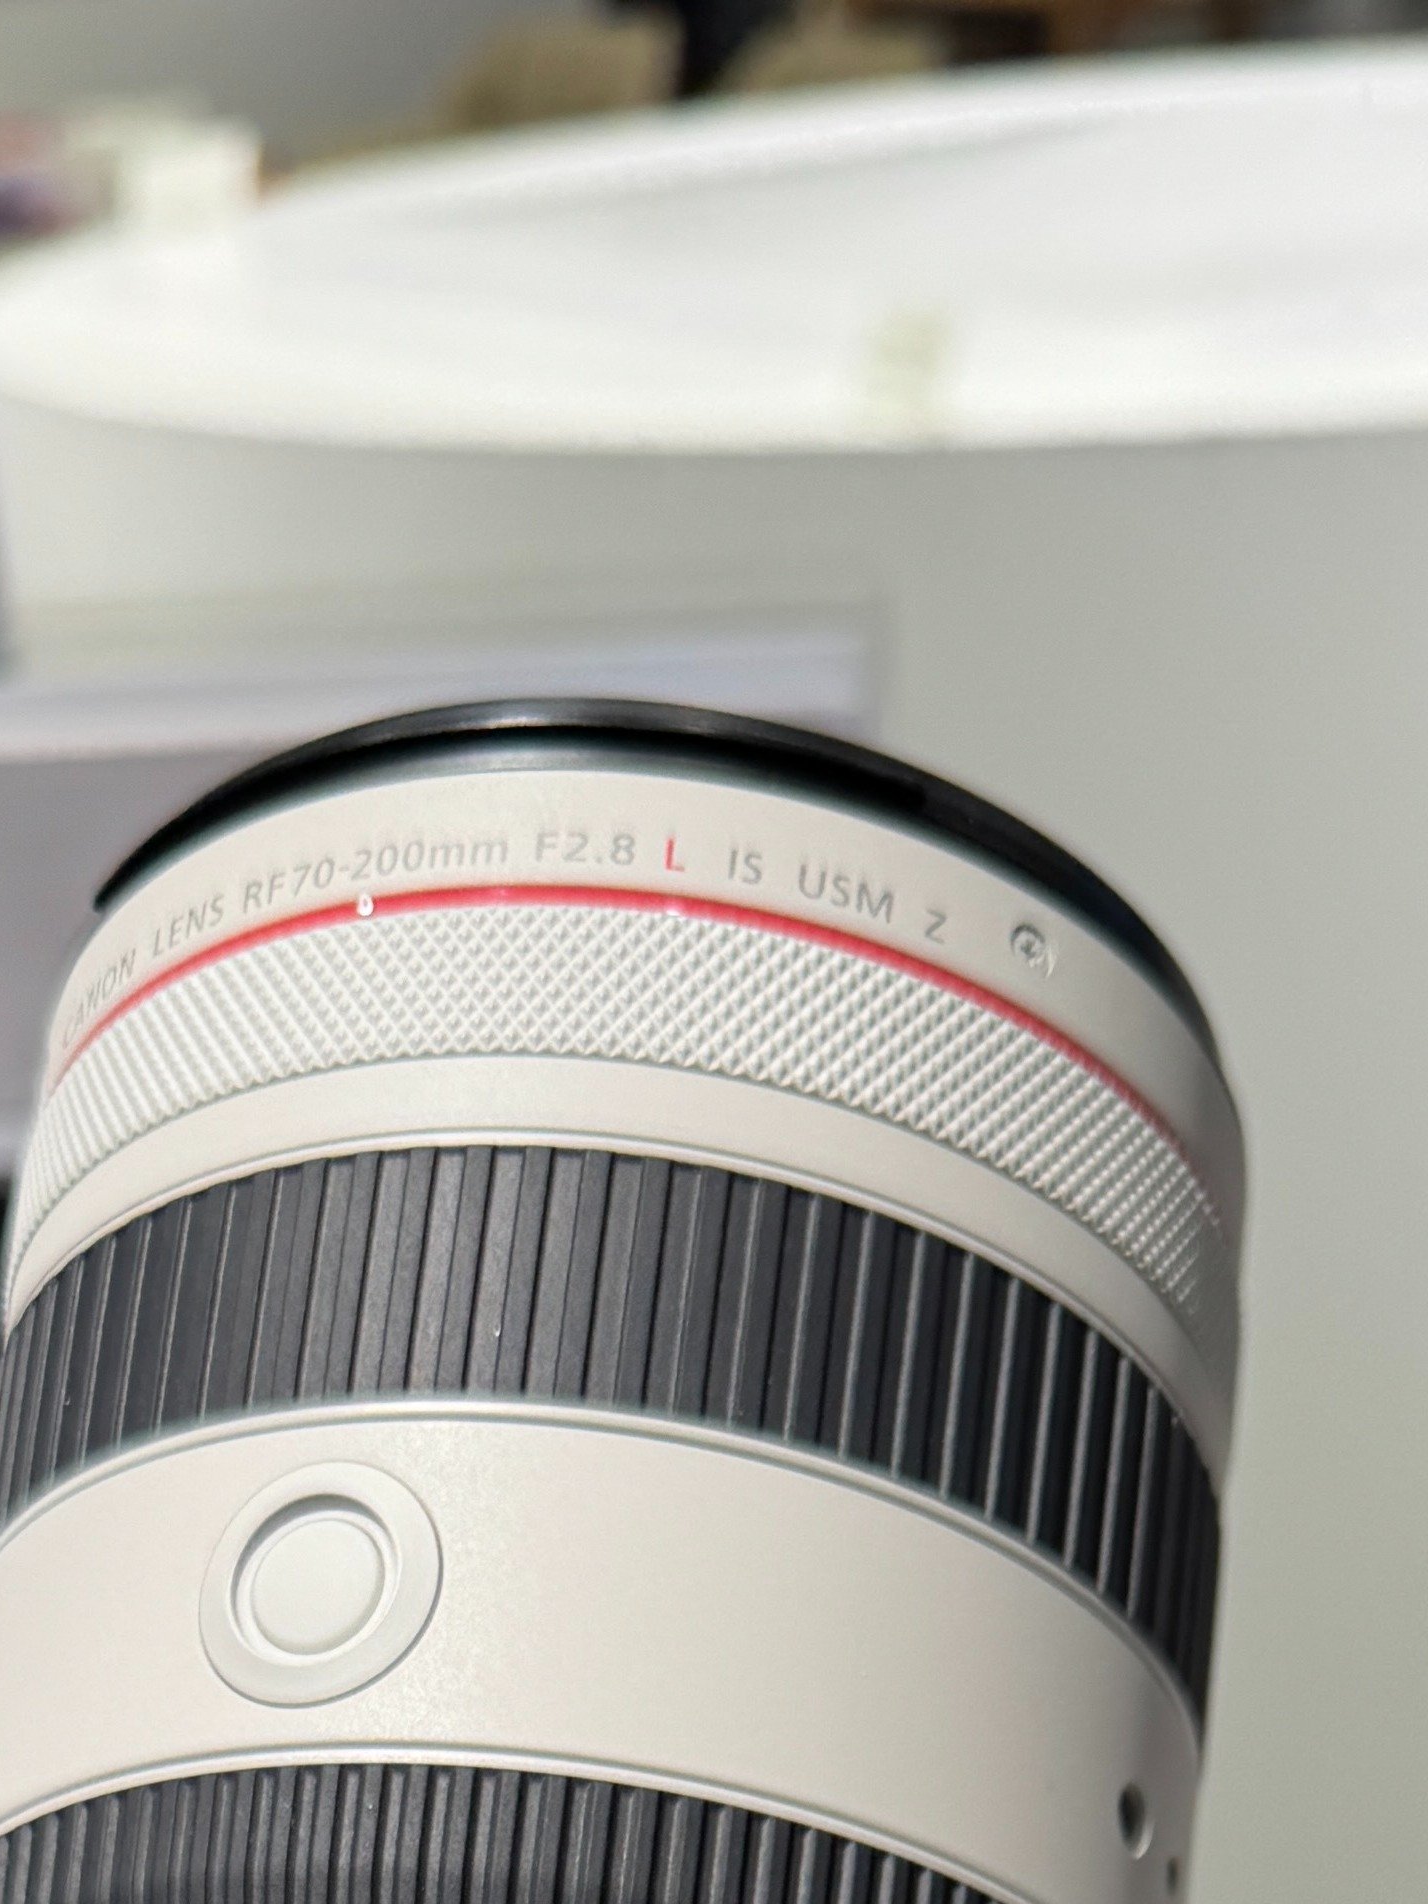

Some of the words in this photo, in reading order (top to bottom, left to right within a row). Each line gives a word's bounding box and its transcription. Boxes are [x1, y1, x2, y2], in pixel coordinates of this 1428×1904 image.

[62, 947, 137, 1049] CANON
[152, 895, 225, 956] LENS
[241, 835, 509, 915] RF70-200mm
[534, 830, 636, 867] F2.8
[664, 838, 686, 872] L
[727, 848, 764, 885] IS
[798, 862, 896, 925] USM
[922, 909, 950, 945] Z
